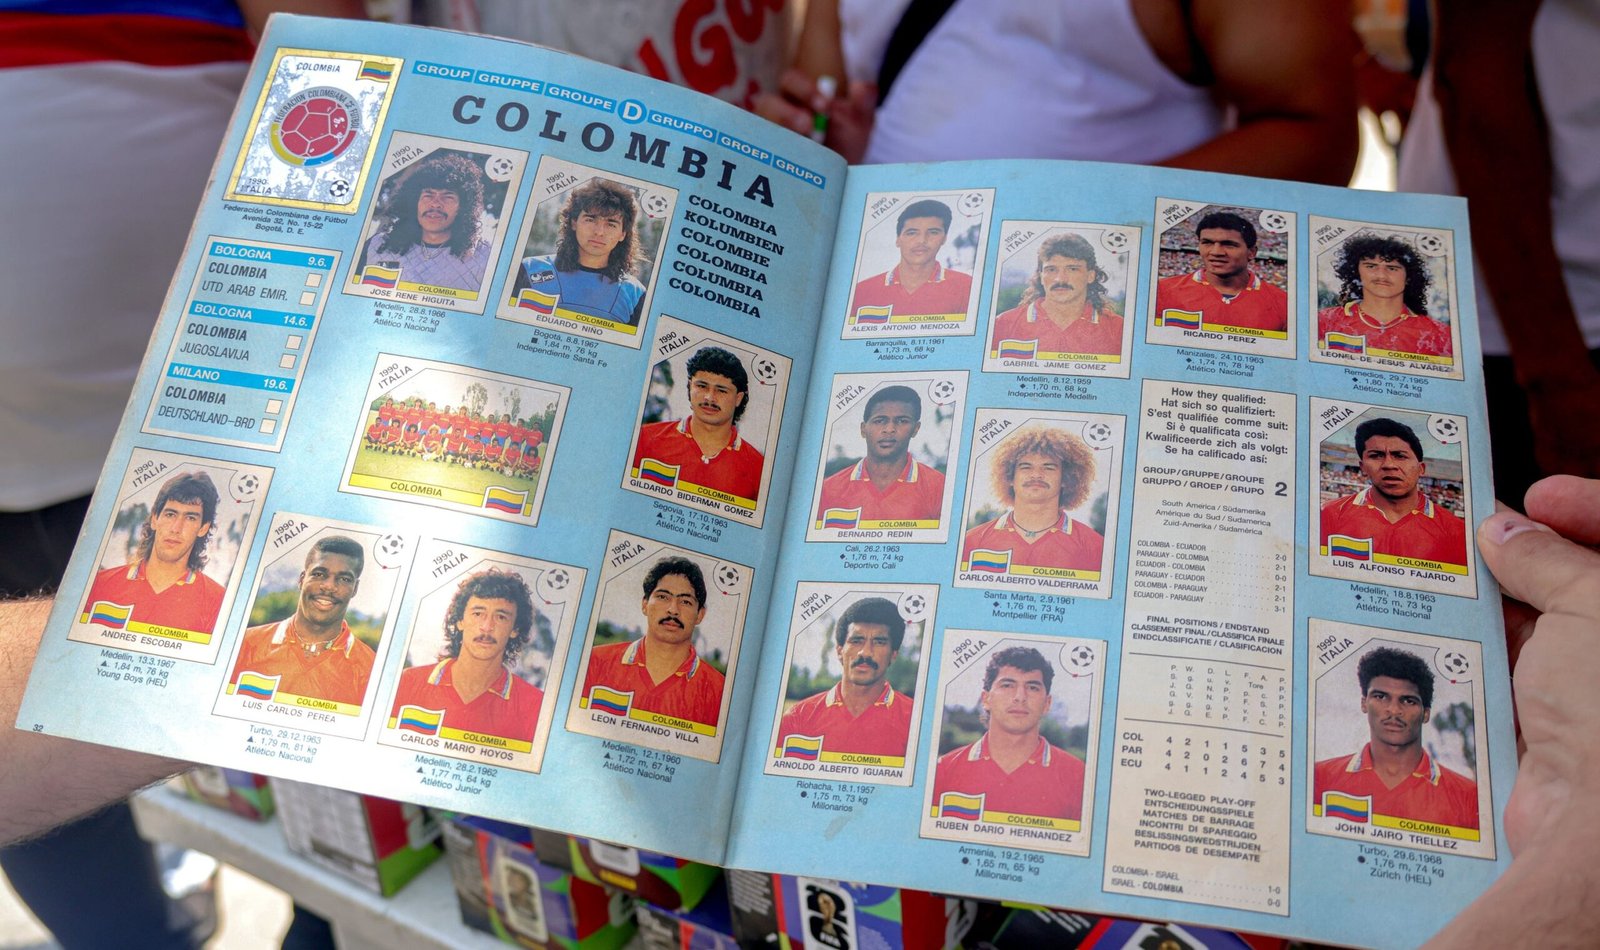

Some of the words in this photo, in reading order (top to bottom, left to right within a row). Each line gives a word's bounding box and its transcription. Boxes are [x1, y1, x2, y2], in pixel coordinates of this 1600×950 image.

[296, 62, 340, 73] COLOMBIA
[416, 64, 470, 78] GROUP
[479, 73, 540, 91] GRUPPE
[548, 87, 612, 109] GROUPE
[623, 103, 643, 120] D
[651, 115, 713, 138] GRUPPO
[721, 137, 769, 159] GROEP
[776, 160, 823, 185] GRUPO
[452, 95, 775, 208] COLOMBIA
[240, 214, 272, 223] Avenida
[301, 221, 324, 229] 15-22
[265, 209, 310, 219] Colombiana
[689, 195, 777, 236] COLOMBIA
[684, 210, 784, 255] KOLUMBIEN
[214, 245, 272, 260] BOLOGNA
[307, 256, 327, 267] 9.6.
[681, 227, 770, 267] COLOMBIE
[207, 262, 268, 279] COLOMBIA
[677, 244, 767, 284] COLOMBIA
[201, 280, 224, 292] UTD
[226, 284, 256, 297] ARAB
[259, 288, 289, 301] EMIR.
[673, 261, 763, 301] COLUMBIA
[369, 288, 391, 298] JOSE
[394, 292, 417, 302] RENE
[421, 295, 455, 307] HIGUITA
[669, 278, 760, 318] COLOMBIA
[193, 304, 253, 320] BOLOGNA
[282, 314, 309, 326] 14.6.
[535, 314, 578, 330] EDUARDO
[581, 323, 604, 335] NIÑO
[186, 323, 247, 340] COLOMBIA
[1183, 330, 1223, 340] RICARDO
[1227, 335, 1256, 344] PEREZ
[179, 342, 250, 360] JUGOSLAVIJA
[516, 341, 570, 361] Independiente
[572, 354, 595, 365] Santa
[597, 359, 608, 367] Fe
[1320, 351, 1355, 361] LEONEL
[1376, 357, 1405, 366] JESUS
[1002, 360, 1039, 368] GABRIEL
[172, 366, 220, 382] MILANO
[262, 377, 288, 389] 19.6.
[164, 386, 226, 404] COLOMBIA
[1171, 387, 1193, 397] How
[1196, 390, 1217, 402] they
[1221, 392, 1266, 406] qualified:
[1161, 398, 1178, 408] Hat
[1181, 400, 1201, 410] sich
[1205, 404, 1217, 412] so
[1221, 404, 1275, 419] qualifiziert:
[979, 419, 998, 434] 1990
[1176, 411, 1218, 425] qualifiée
[1224, 417, 1261, 427] comme
[1267, 420, 1288, 430] suit:
[980, 419, 1012, 444] ITALIA
[1166, 422, 1175, 431] Si
[1179, 423, 1185, 432] è
[1189, 424, 1240, 439] qualificata
[1145, 432, 1212, 446] Kwalificeerde
[1216, 439, 1236, 449] zich
[1241, 441, 1255, 450] als
[1260, 443, 1287, 456] volgt:
[1164, 445, 1177, 454] Se
[1181, 447, 1193, 456] ha
[1197, 448, 1246, 461] calificado
[389, 481, 442, 496] COLOMBIA
[1275, 482, 1287, 496] 2
[629, 479, 673, 497] GILDARDO
[676, 492, 720, 509] BIDERMAN
[723, 504, 753, 518] GOMEZ
[842, 562, 879, 571] Deportivo
[1332, 559, 1354, 569] LUIS
[1359, 563, 1405, 575] ALFONSO
[1410, 570, 1455, 582] FAJARDO
[958, 574, 994, 583] CARLOS
[994, 576, 1036, 586] ALBERTO
[1037, 579, 1098, 591] VALDERRAMA
[991, 610, 1037, 622] Montpellier
[1040, 613, 1063, 624] (FRA)
[1391, 607, 1431, 619] Nacional
[100, 629, 138, 642] ANDRES
[139, 636, 183, 650] ESCOBAR
[1317, 635, 1337, 652] 1990
[1319, 637, 1354, 664] ITALIA
[95, 668, 121, 683] Young
[122, 672, 144, 686] Boys
[242, 700, 262, 710] LUIS
[266, 704, 302, 717] CARLOS
[306, 711, 336, 722] PEREA
[590, 714, 616, 726] LEON
[620, 720, 671, 737] FERNANDO
[674, 731, 699, 743] VILLA
[1123, 732, 1143, 741] COL
[400, 733, 439, 748] CARLOS
[443, 741, 476, 754] MARIO
[479, 747, 514, 761] HOYOS
[1122, 746, 1142, 754] PAR
[772, 760, 815, 771] ARNOLDO
[818, 764, 859, 774] ALBERTO
[862, 768, 903, 778] IGUARAN
[1121, 759, 1142, 767] ECU
[1143, 788, 1206, 802] TWO-LEGGED
[1209, 796, 1255, 808] PLAY-OFF
[1143, 799, 1254, 818] ENTSCHEIDUNGSSPIELE
[1142, 809, 1188, 821] MATCHES
[1191, 815, 1204, 823] DE
[1209, 817, 1254, 829] BARRAGE
[1398, 820, 1451, 836] COLOMBIA
[935, 821, 968, 831] RUBEN
[973, 824, 1004, 835] DARIO
[1009, 828, 1072, 842] HERNANDEZ
[1138, 819, 1183, 831] INCONTRI
[1187, 825, 1198, 833] DI
[1202, 827, 1257, 840] SPAREGGIO
[1334, 823, 1365, 836] JOHN
[1370, 828, 1403, 841] JAIRO
[1408, 834, 1457, 849] TRELLEZ
[1134, 829, 1261, 851] BESLISSINGSWEDSTRIJDEN
[1133, 840, 1181, 852] PARTIDOS
[1184, 846, 1198, 854] DE
[1202, 848, 1260, 862] DESEMPATE
[1369, 868, 1401, 881] Zürich
